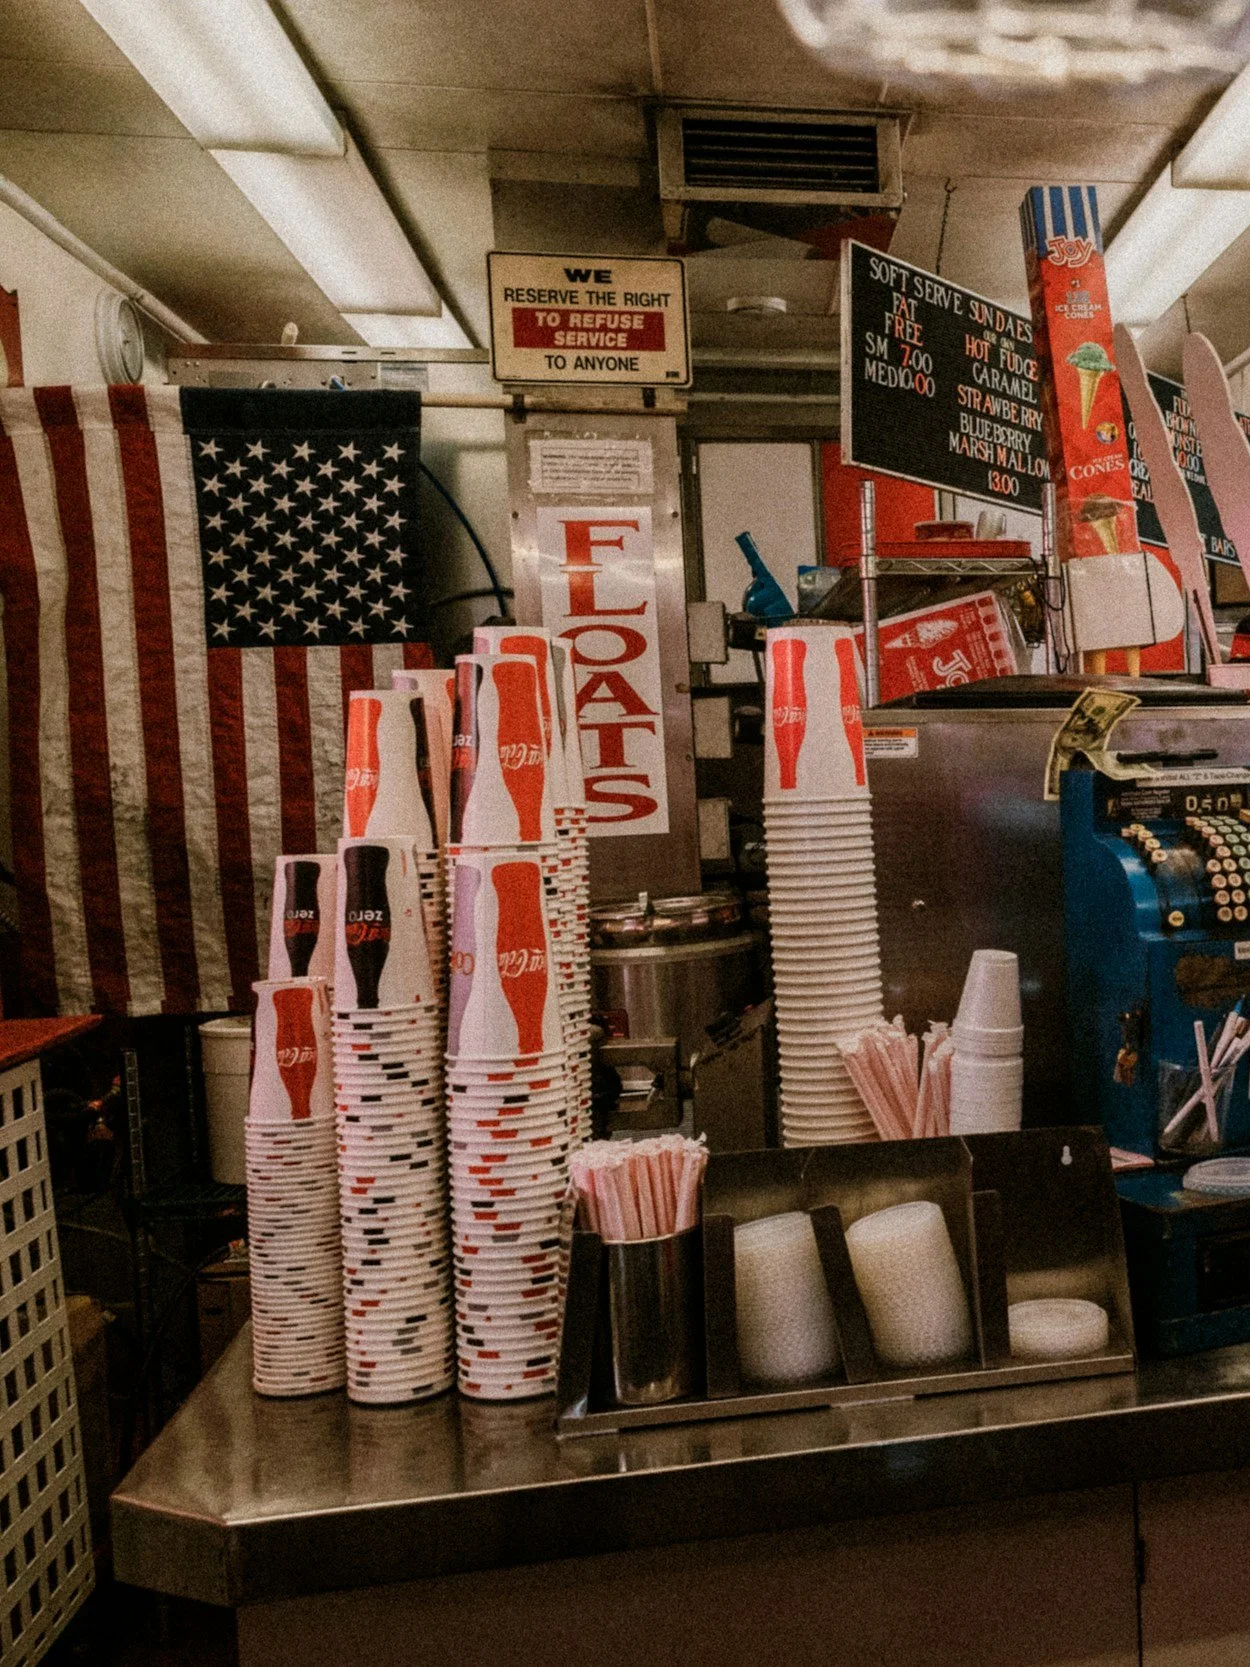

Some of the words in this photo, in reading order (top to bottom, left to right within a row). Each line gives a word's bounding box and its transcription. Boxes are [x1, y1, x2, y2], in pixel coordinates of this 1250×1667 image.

[564, 268, 613, 284] WE
[504, 288, 579, 305] RESERVE
[586, 291, 616, 306] THE
[624, 292, 671, 307] RIGHT
[869, 257, 909, 292] SOFT
[914, 276, 963, 315] SERVE
[968, 300, 1033, 343] SUNDAES
[892, 292, 918, 321] FAT
[535, 311, 561, 327] TO
[569, 313, 644, 329] REFUSE
[884, 312, 923, 346] FREE
[554, 331, 628, 347] SERVICE
[865, 332, 888, 360] SM
[900, 344, 933, 375] 7.00
[965, 333, 991, 363] HOT
[545, 355, 566, 370] TO
[574, 357, 640, 371] ANYONE
[972, 362, 1037, 404] CARAMEL
[957, 384, 1043, 432] STRAWBERRY
[960, 412, 1032, 453] BLUEBERRY
[1069, 459, 1125, 480] CONES
[349, 909, 383, 923] zero
